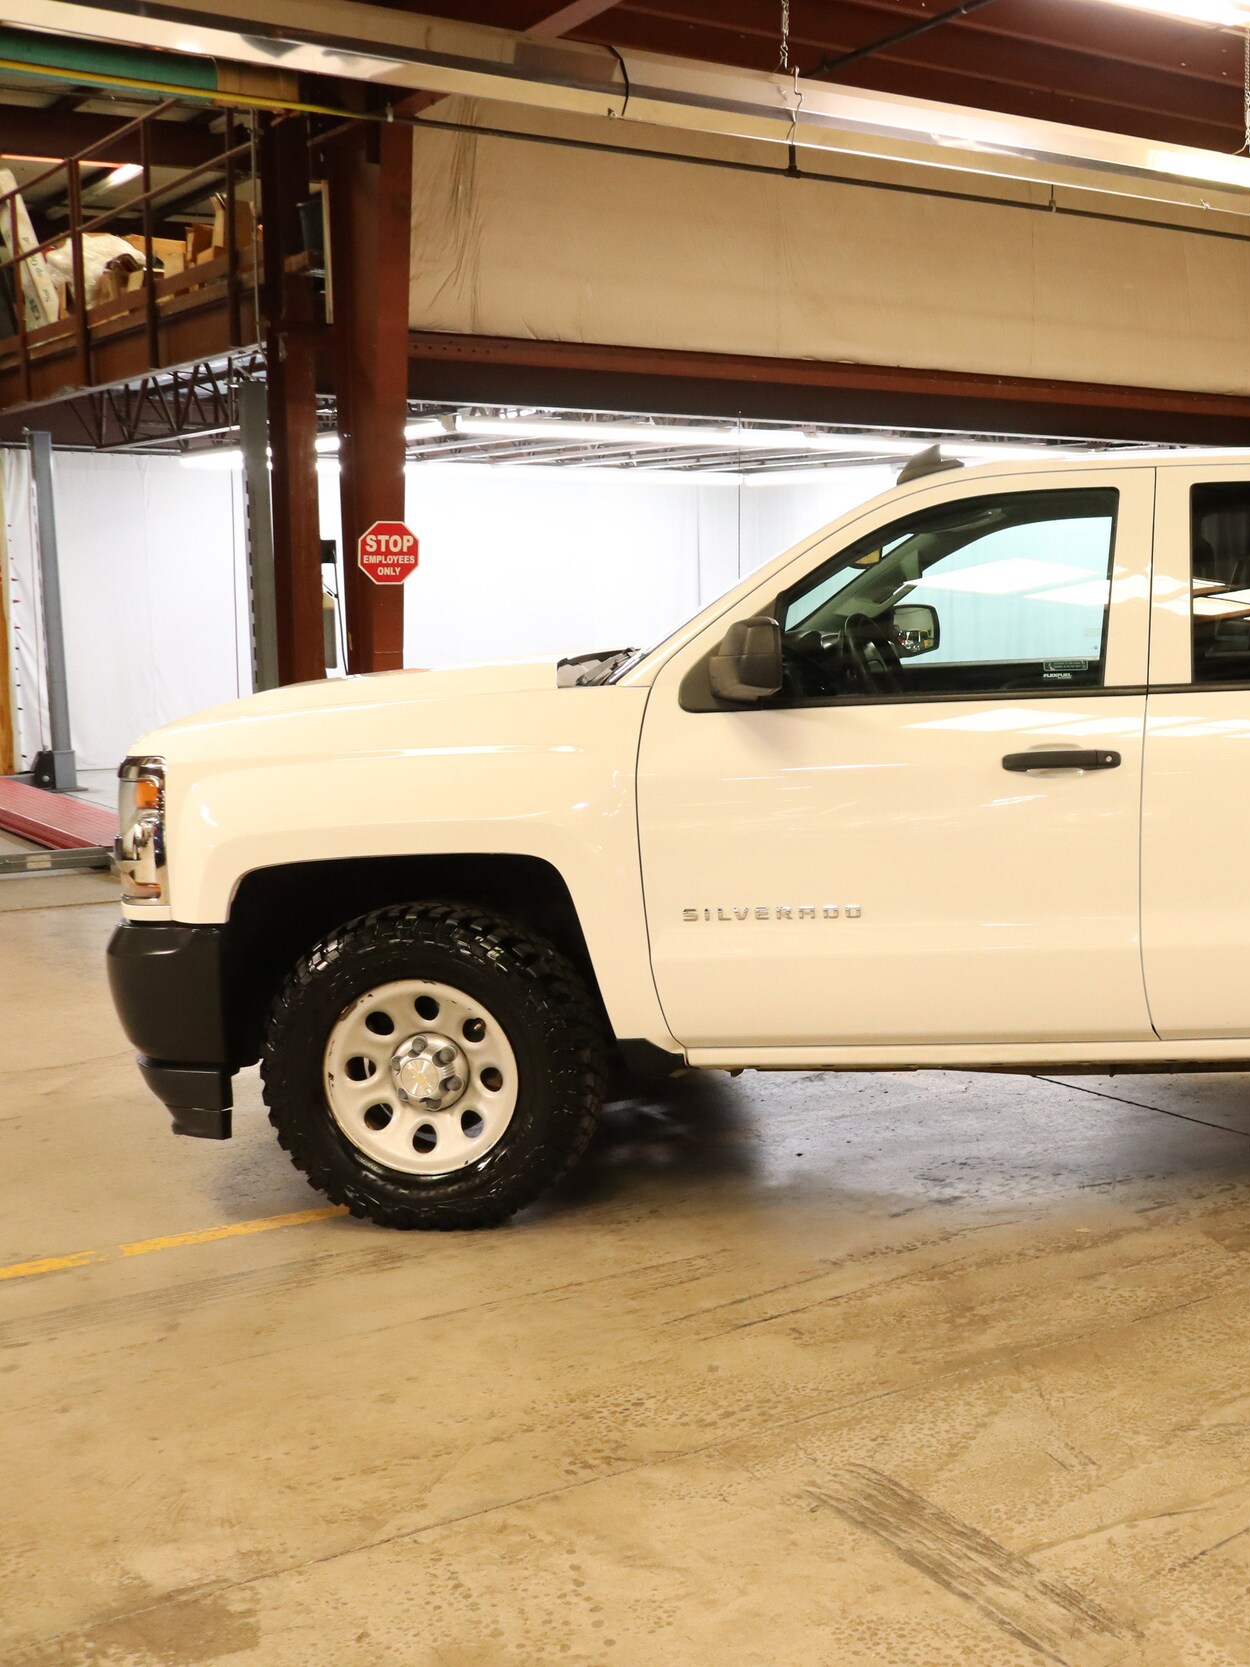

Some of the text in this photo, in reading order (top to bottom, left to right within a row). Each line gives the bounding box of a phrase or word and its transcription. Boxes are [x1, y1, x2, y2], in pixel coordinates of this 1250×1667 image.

[365, 534, 414, 552] STOP
[363, 555, 415, 564] EMPLOYEES
[377, 567, 401, 576] ONLY
[682, 904, 862, 922] SILVERADO
